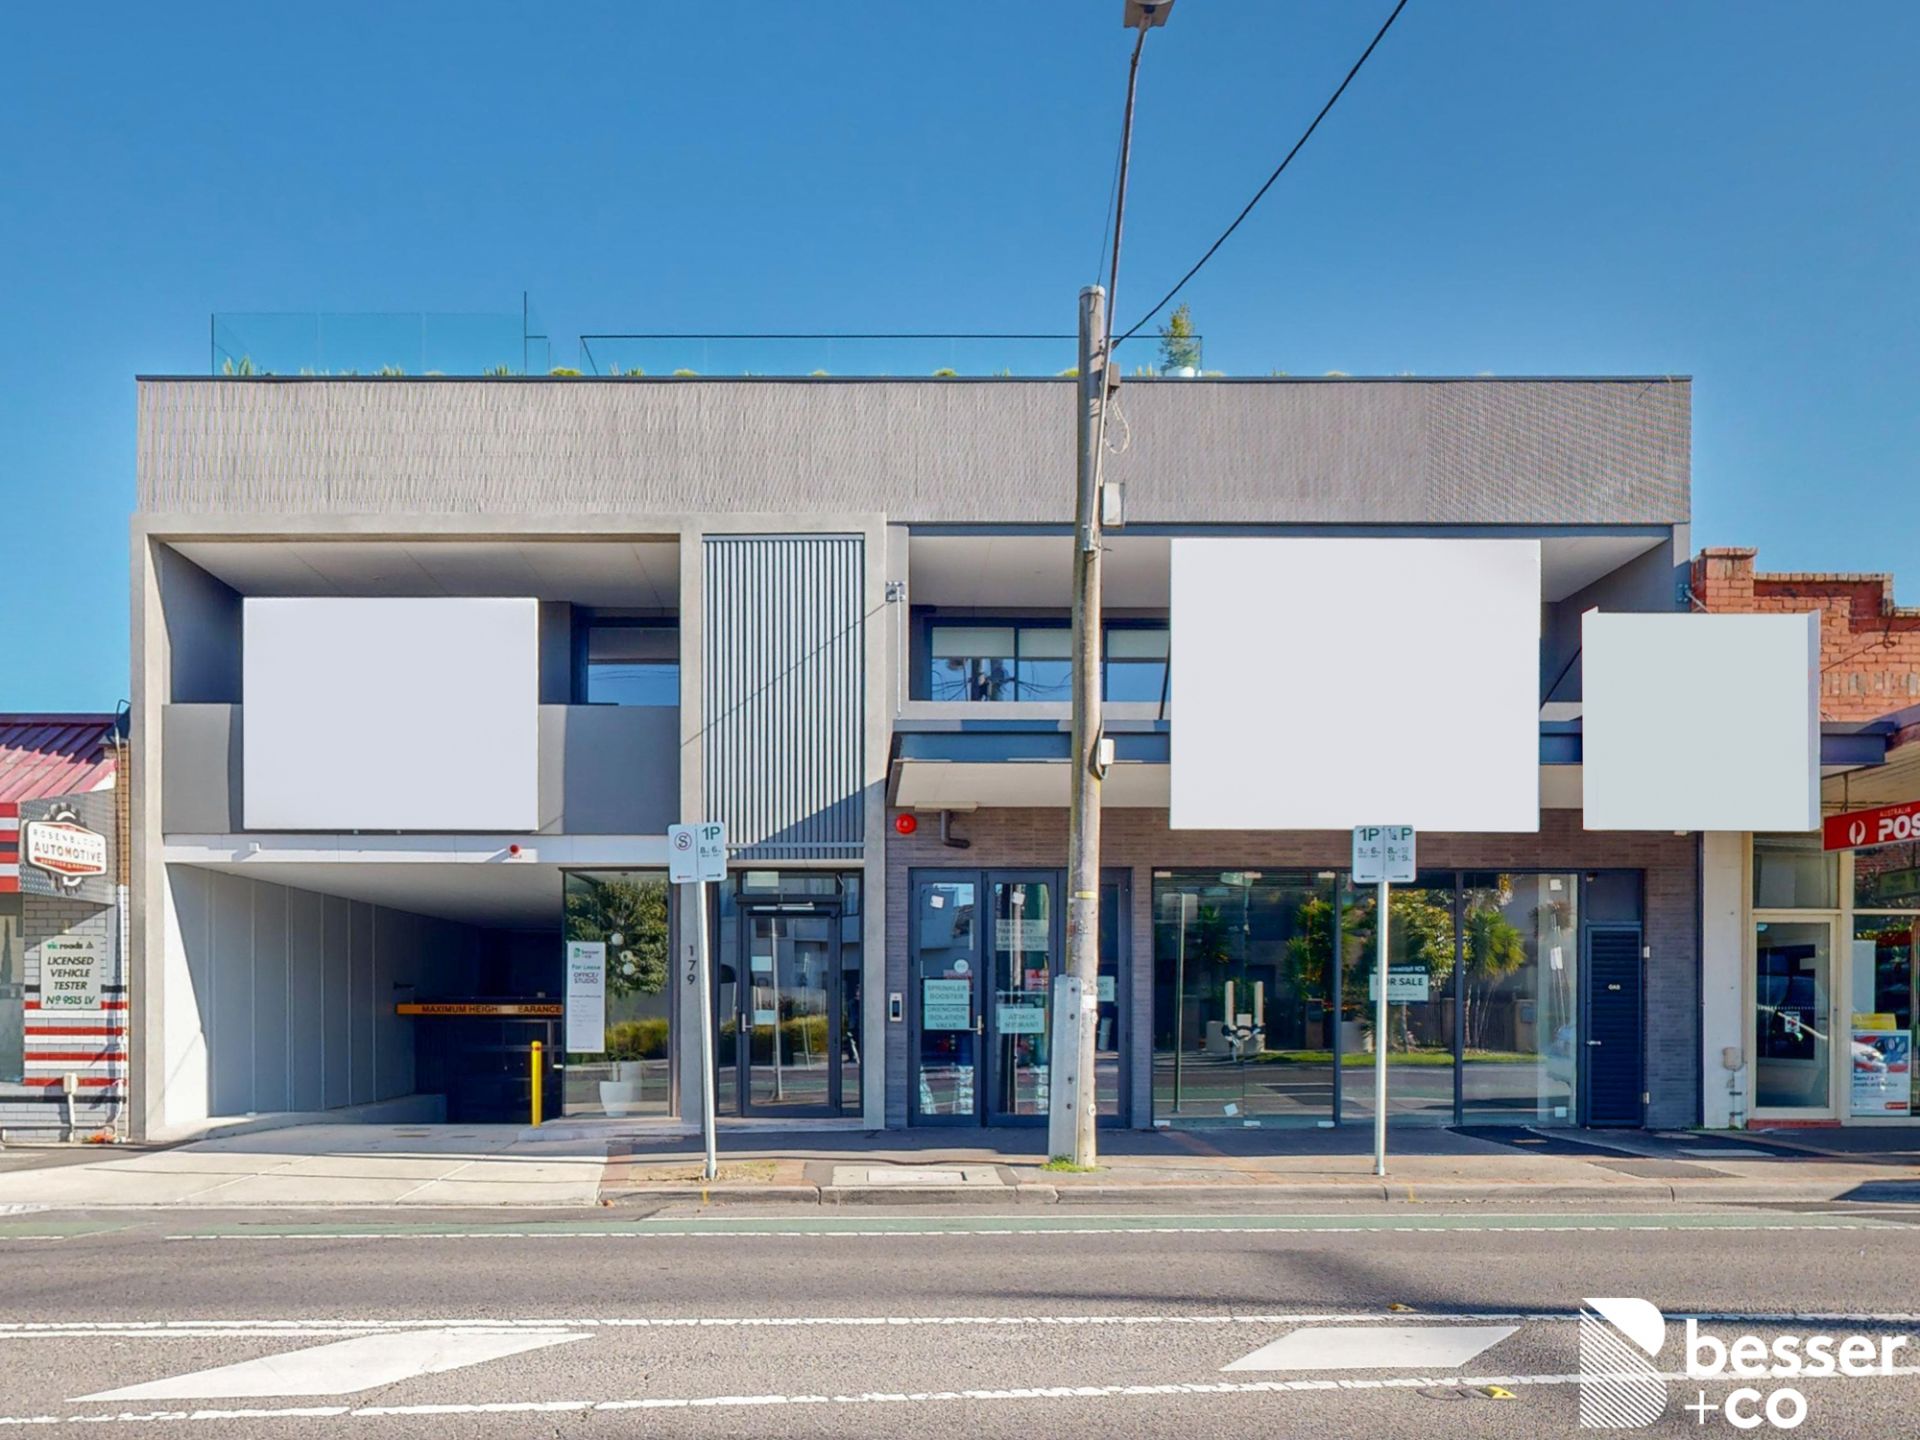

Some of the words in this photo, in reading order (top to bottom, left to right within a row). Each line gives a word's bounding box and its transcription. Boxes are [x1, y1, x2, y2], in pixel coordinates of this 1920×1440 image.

[702, 826, 721, 840] 1P
[1359, 828, 1380, 841] 1P
[34, 841, 102, 863] AUTOMOTIVE
[47, 956, 94, 965] LICENSED
[686, 945, 697, 984] 179
[50, 969, 90, 977] VEHICLE
[54, 981, 87, 990] TESTER
[1400, 977, 1423, 986] SALE
[422, 1005, 466, 1013] MAXIMUM
[469, 1005, 498, 1013] HEIGH
